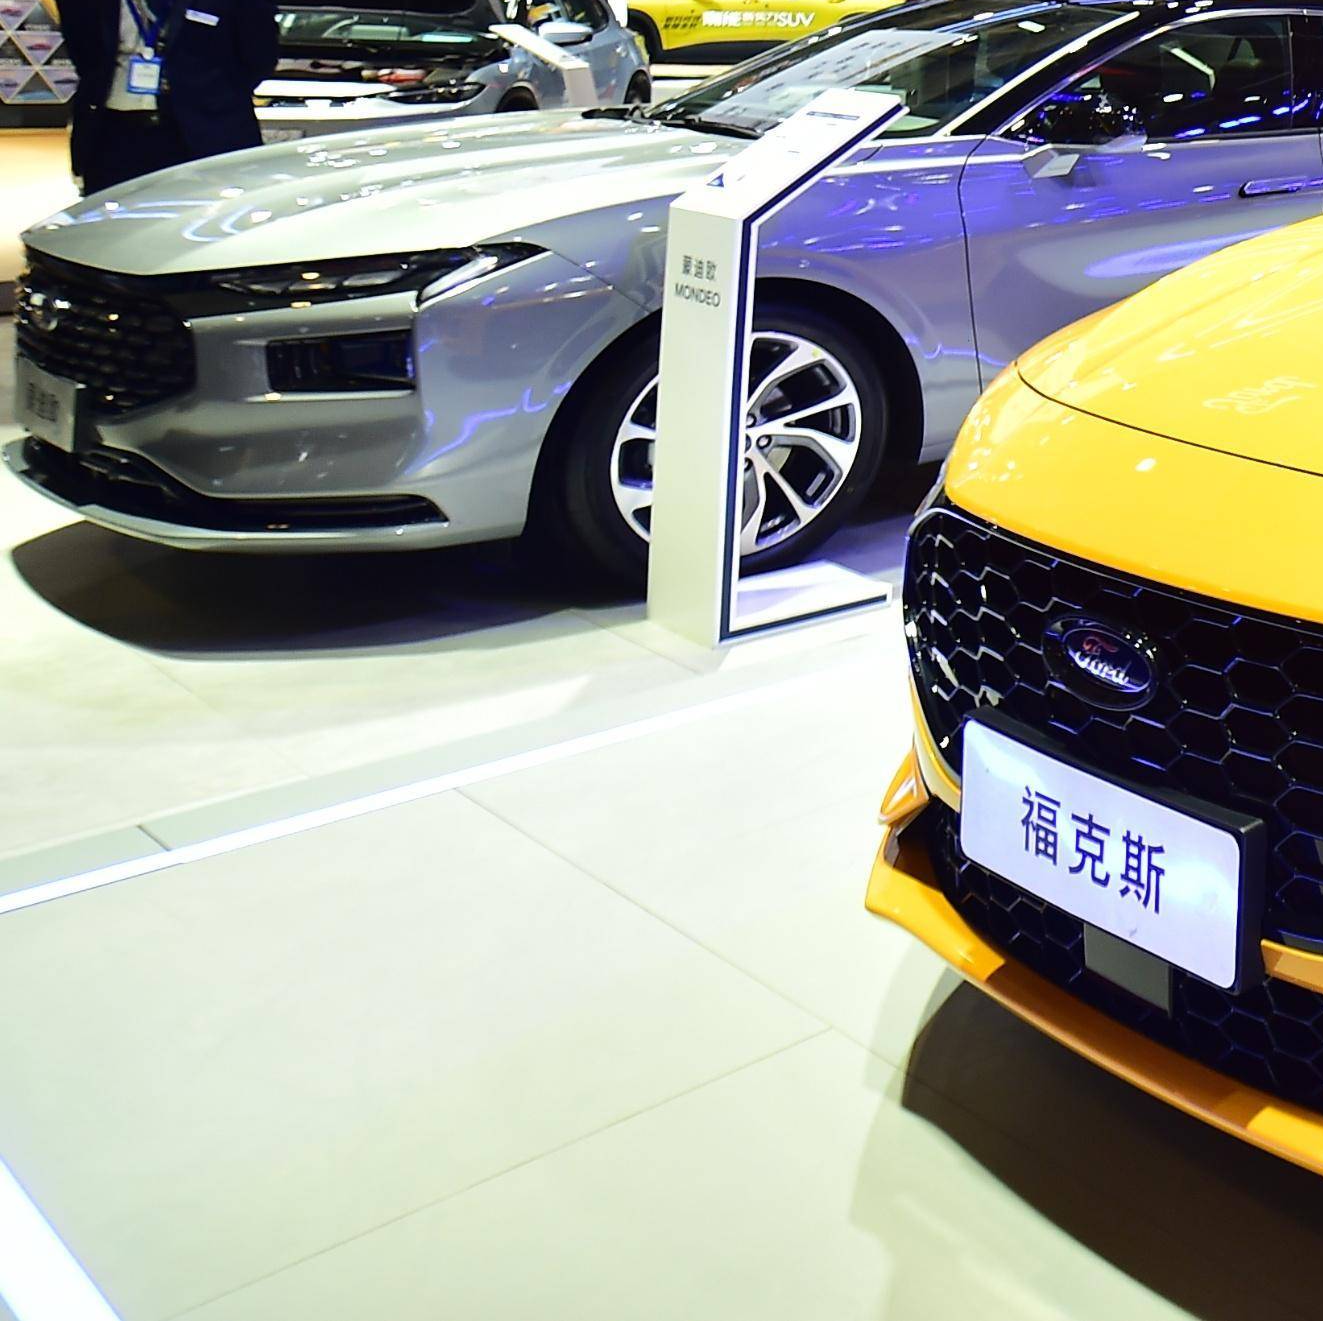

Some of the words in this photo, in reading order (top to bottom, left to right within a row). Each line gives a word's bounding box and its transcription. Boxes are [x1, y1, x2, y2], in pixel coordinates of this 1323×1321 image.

[675, 283, 721, 308] MONDEO
[1021, 785, 1165, 914] 福克斯
